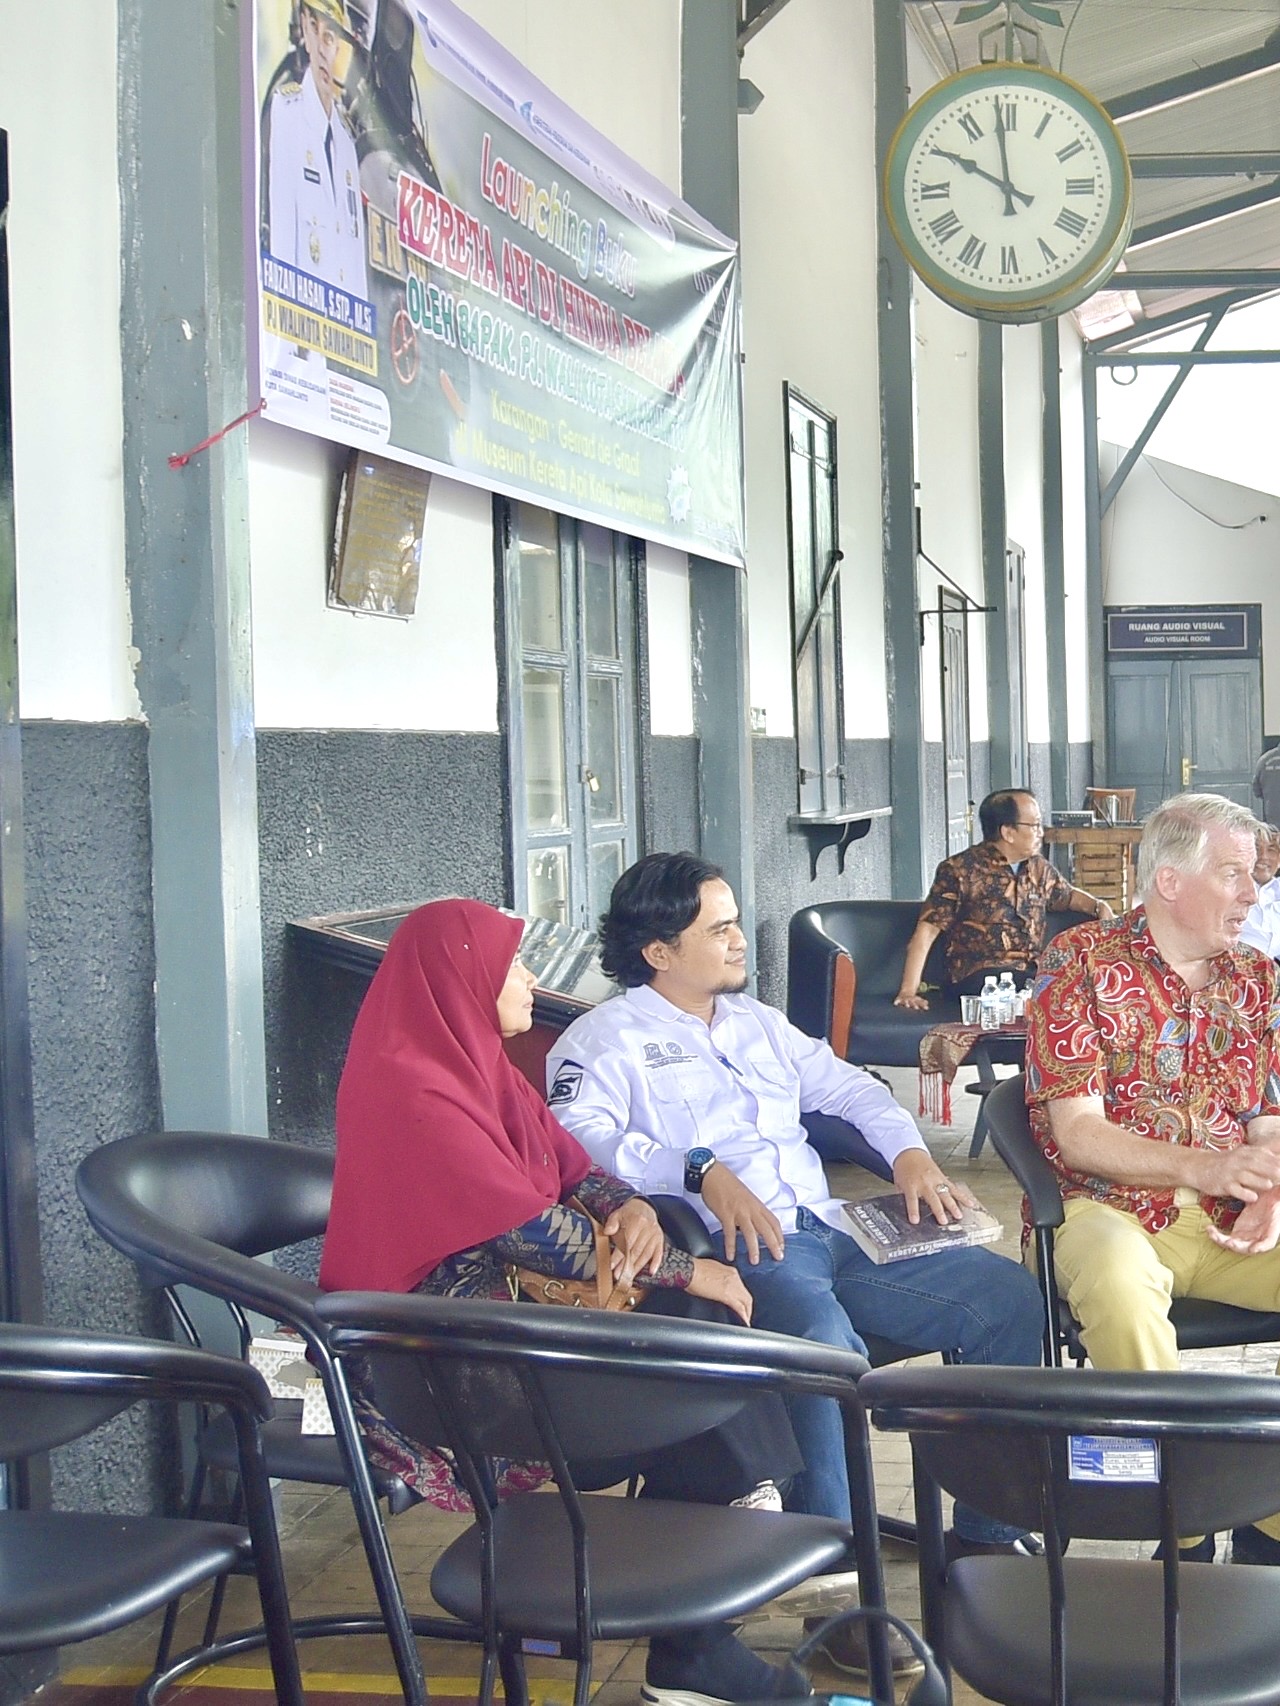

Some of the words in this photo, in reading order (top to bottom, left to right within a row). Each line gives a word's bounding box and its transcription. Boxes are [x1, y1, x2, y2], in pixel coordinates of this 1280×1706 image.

[480, 132, 591, 280] Launching
[594, 217, 637, 299] Buku
[263, 258, 296, 301] FAUZAN
[296, 275, 328, 318] HASAN,
[354, 301, 372, 334] M.Si
[397, 169, 499, 297] KERETA
[501, 236, 537, 318] API
[535, 258, 561, 332] DI
[560, 274, 623, 366] HINDIA
[265, 300, 278, 330] PJ
[279, 305, 321, 348] WALIKOTA
[322, 322, 374, 370] SAWAHLUNTO
[406, 271, 456, 349] OLEH
[456, 299, 517, 377] BAPAK.
[519, 331, 543, 388] PJ.
[490, 387, 549, 443] Karangan
[471, 427, 526, 478] Museum
[528, 448, 567, 492] Kereta
[1128, 622, 1160, 632] RUANG
[1161, 622, 1191, 631] AUDIO
[1191, 621, 1226, 631] VISUAL
[1143, 636, 1165, 644] AUDIO
[1165, 635, 1190, 644] VISUAL
[1189, 635, 1212, 643] ROOM
[852, 1205, 871, 1219] API
[865, 1218, 892, 1245] KERETA
[887, 1248, 918, 1259] KERETA
[918, 1243, 934, 1254] API
